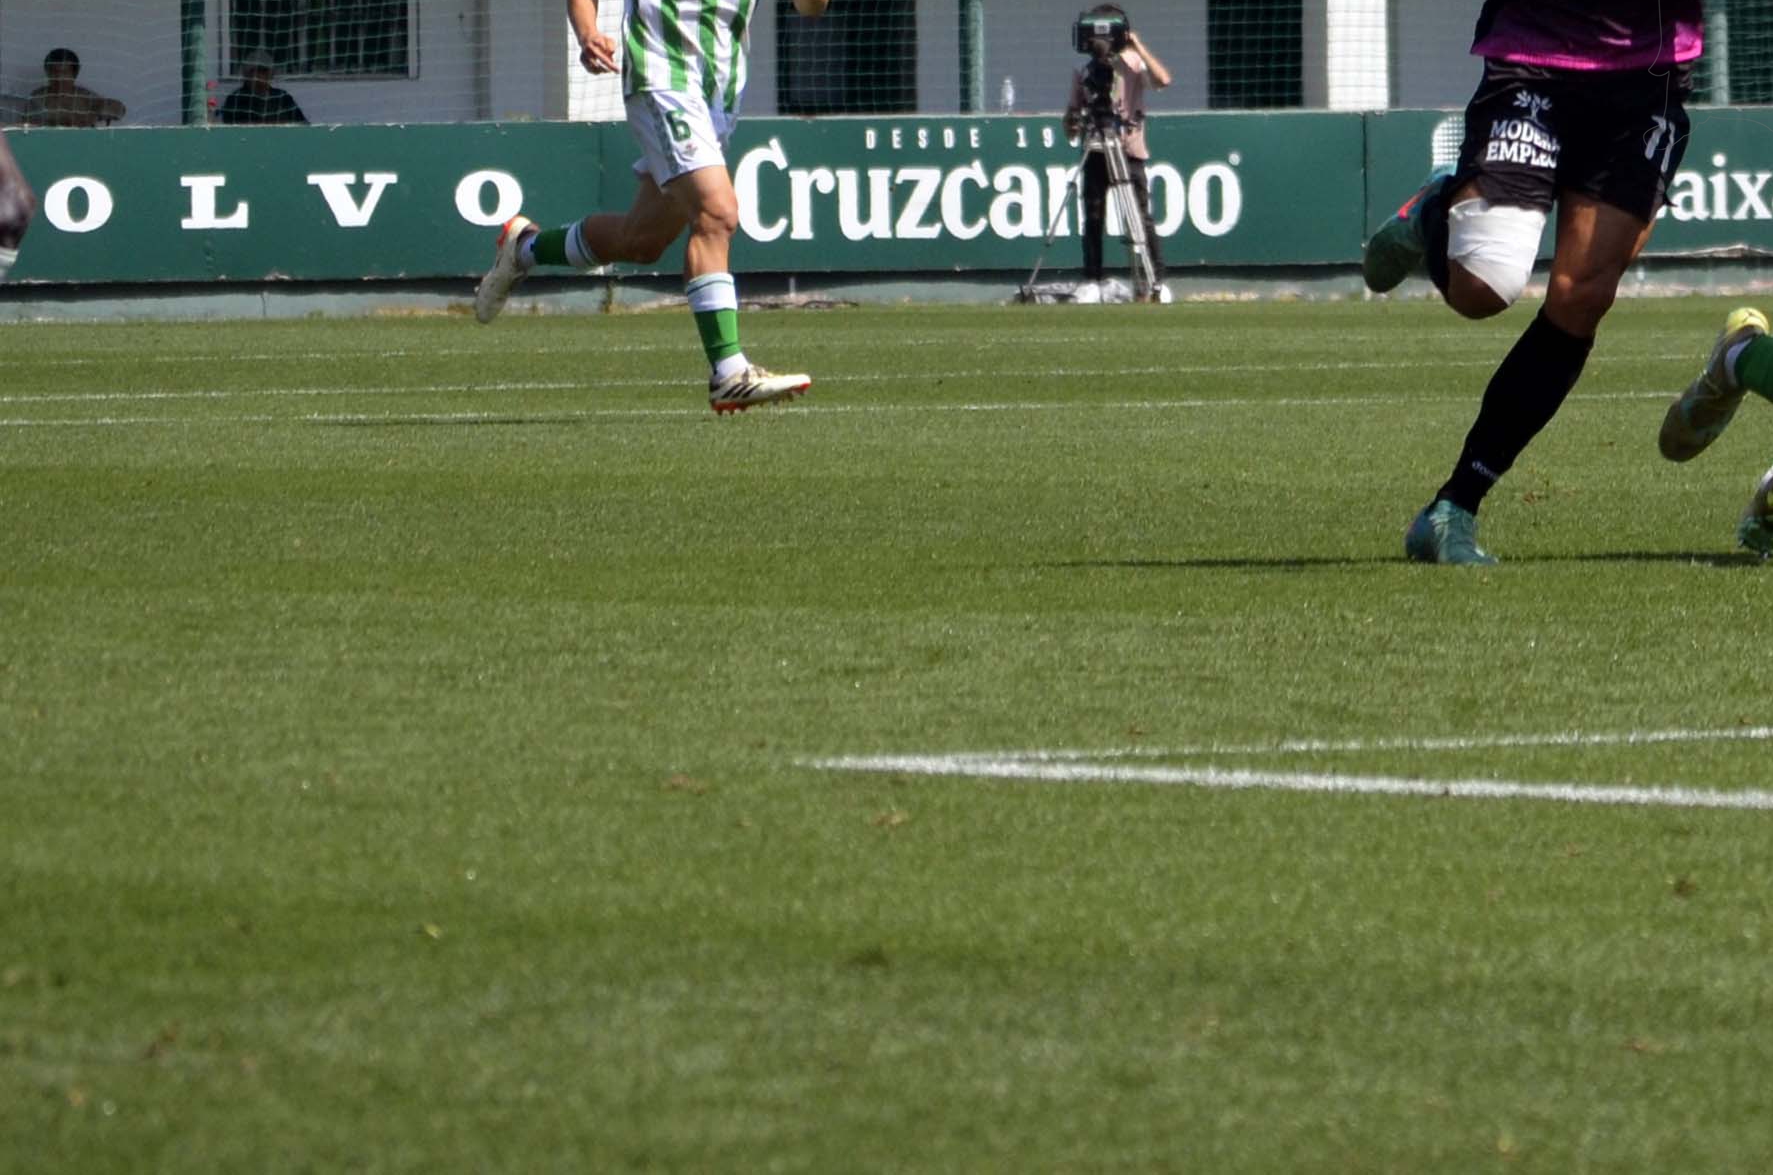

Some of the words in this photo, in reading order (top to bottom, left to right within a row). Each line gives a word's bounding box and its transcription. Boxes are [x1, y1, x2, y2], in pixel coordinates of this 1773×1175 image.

[666, 109, 692, 142] 6
[864, 126, 981, 150] DESDE
[43, 169, 524, 233] OLVO
